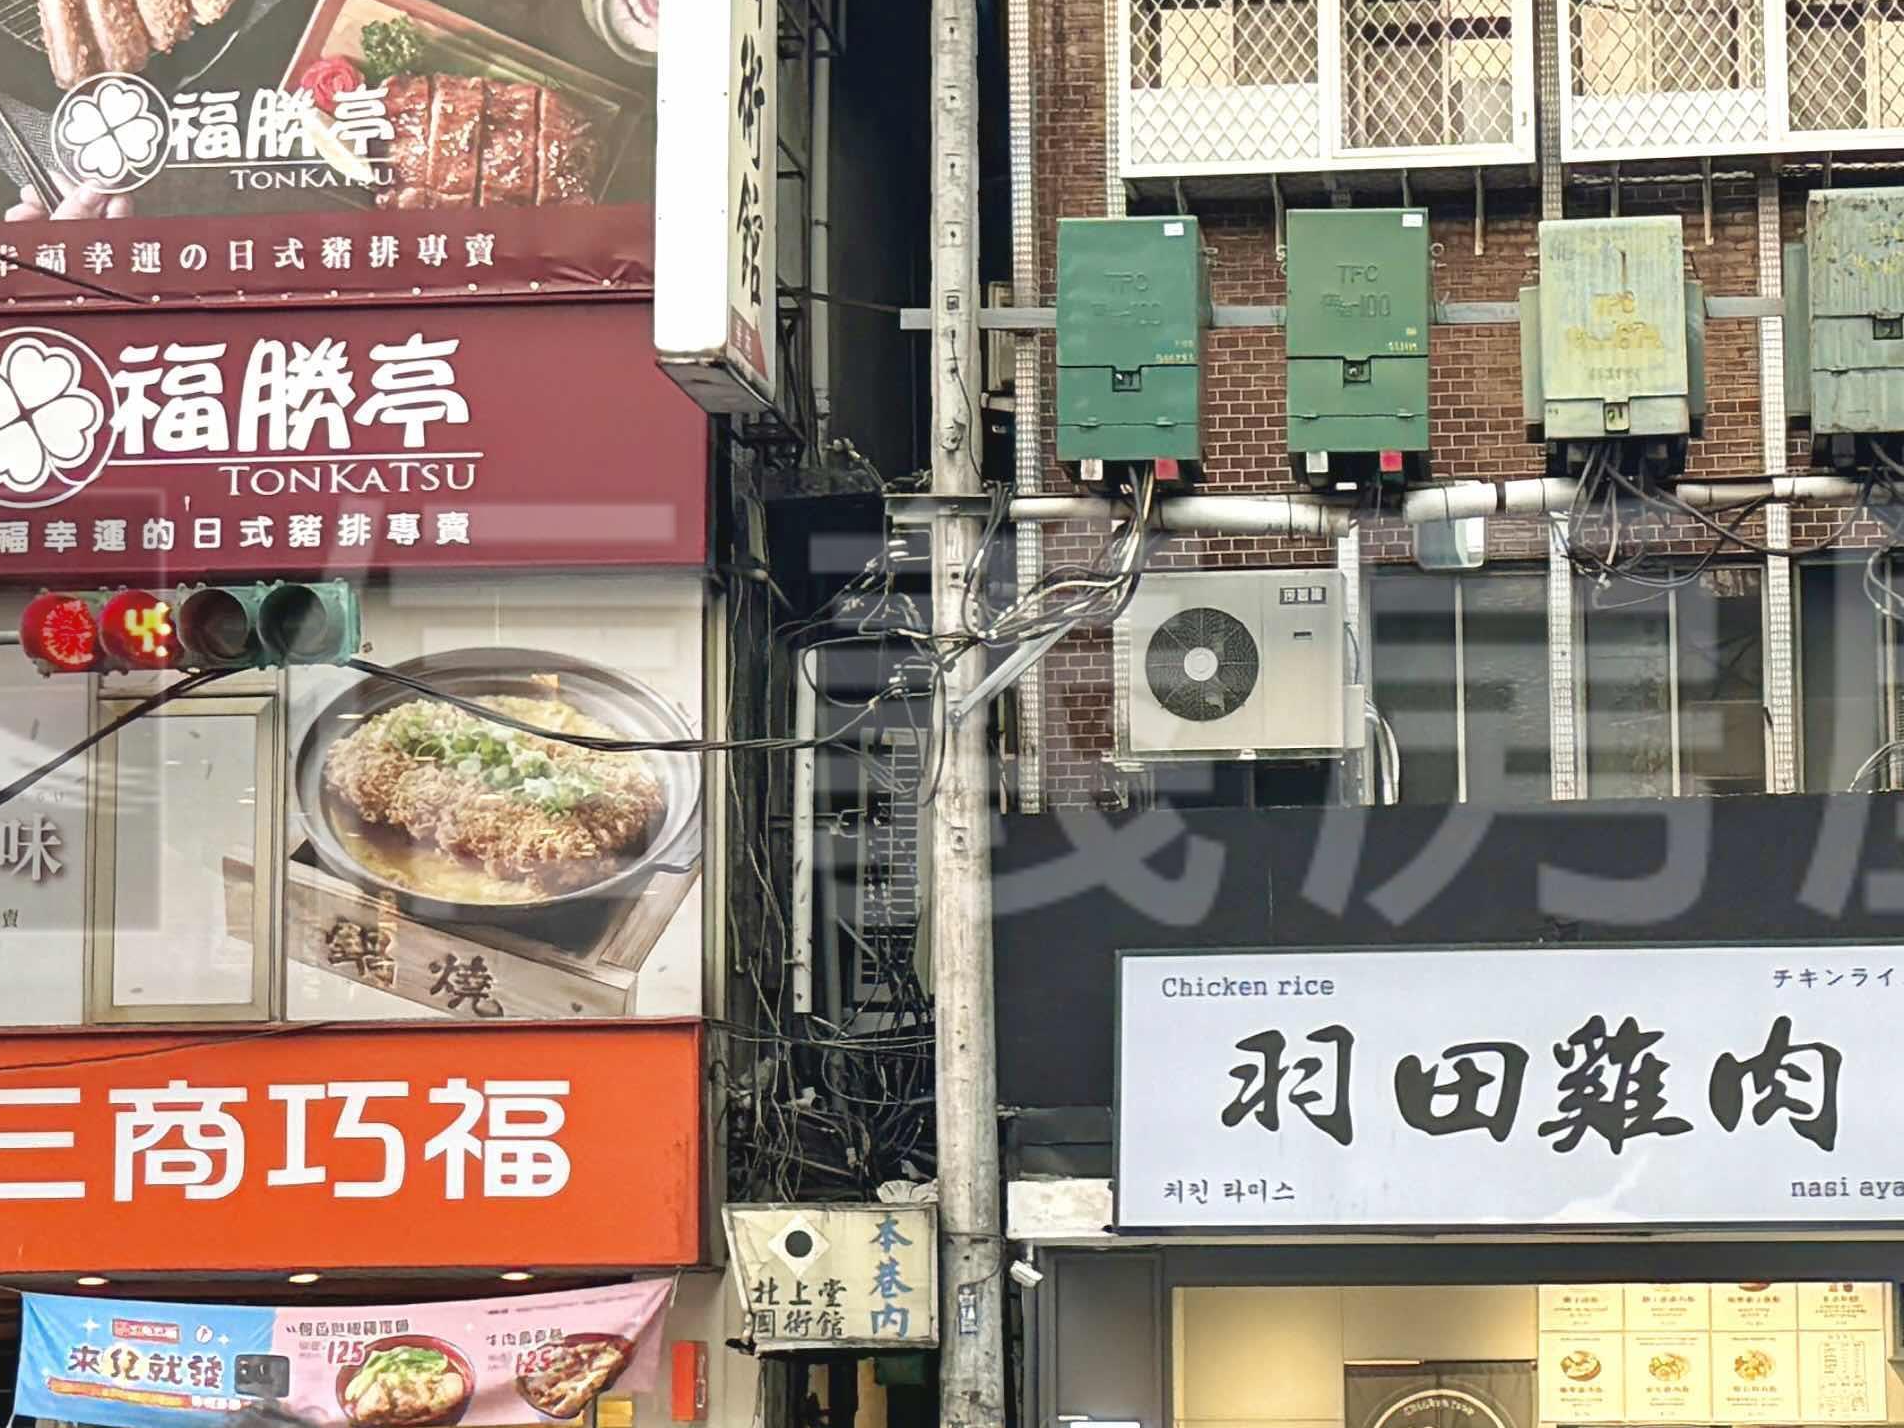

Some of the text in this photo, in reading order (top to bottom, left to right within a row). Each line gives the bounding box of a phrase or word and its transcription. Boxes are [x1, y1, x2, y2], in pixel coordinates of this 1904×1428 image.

[164, 86, 394, 163] 福勝亭
[108, 332, 471, 455] 福勝亭
[220, 463, 478, 498] TONKATSU
[1162, 974, 1336, 999] Chicken rice
[1220, 1015, 1843, 1157] 羽田雞肉
[1163, 1178, 1210, 1205] 치킨
[1790, 1176, 1852, 1200] nasi
[870, 1213, 913, 1339] 本巷內
[752, 1277, 848, 1309] 北上堂
[754, 1309, 846, 1341] 國術館
[327, 1341, 365, 1365] 125
